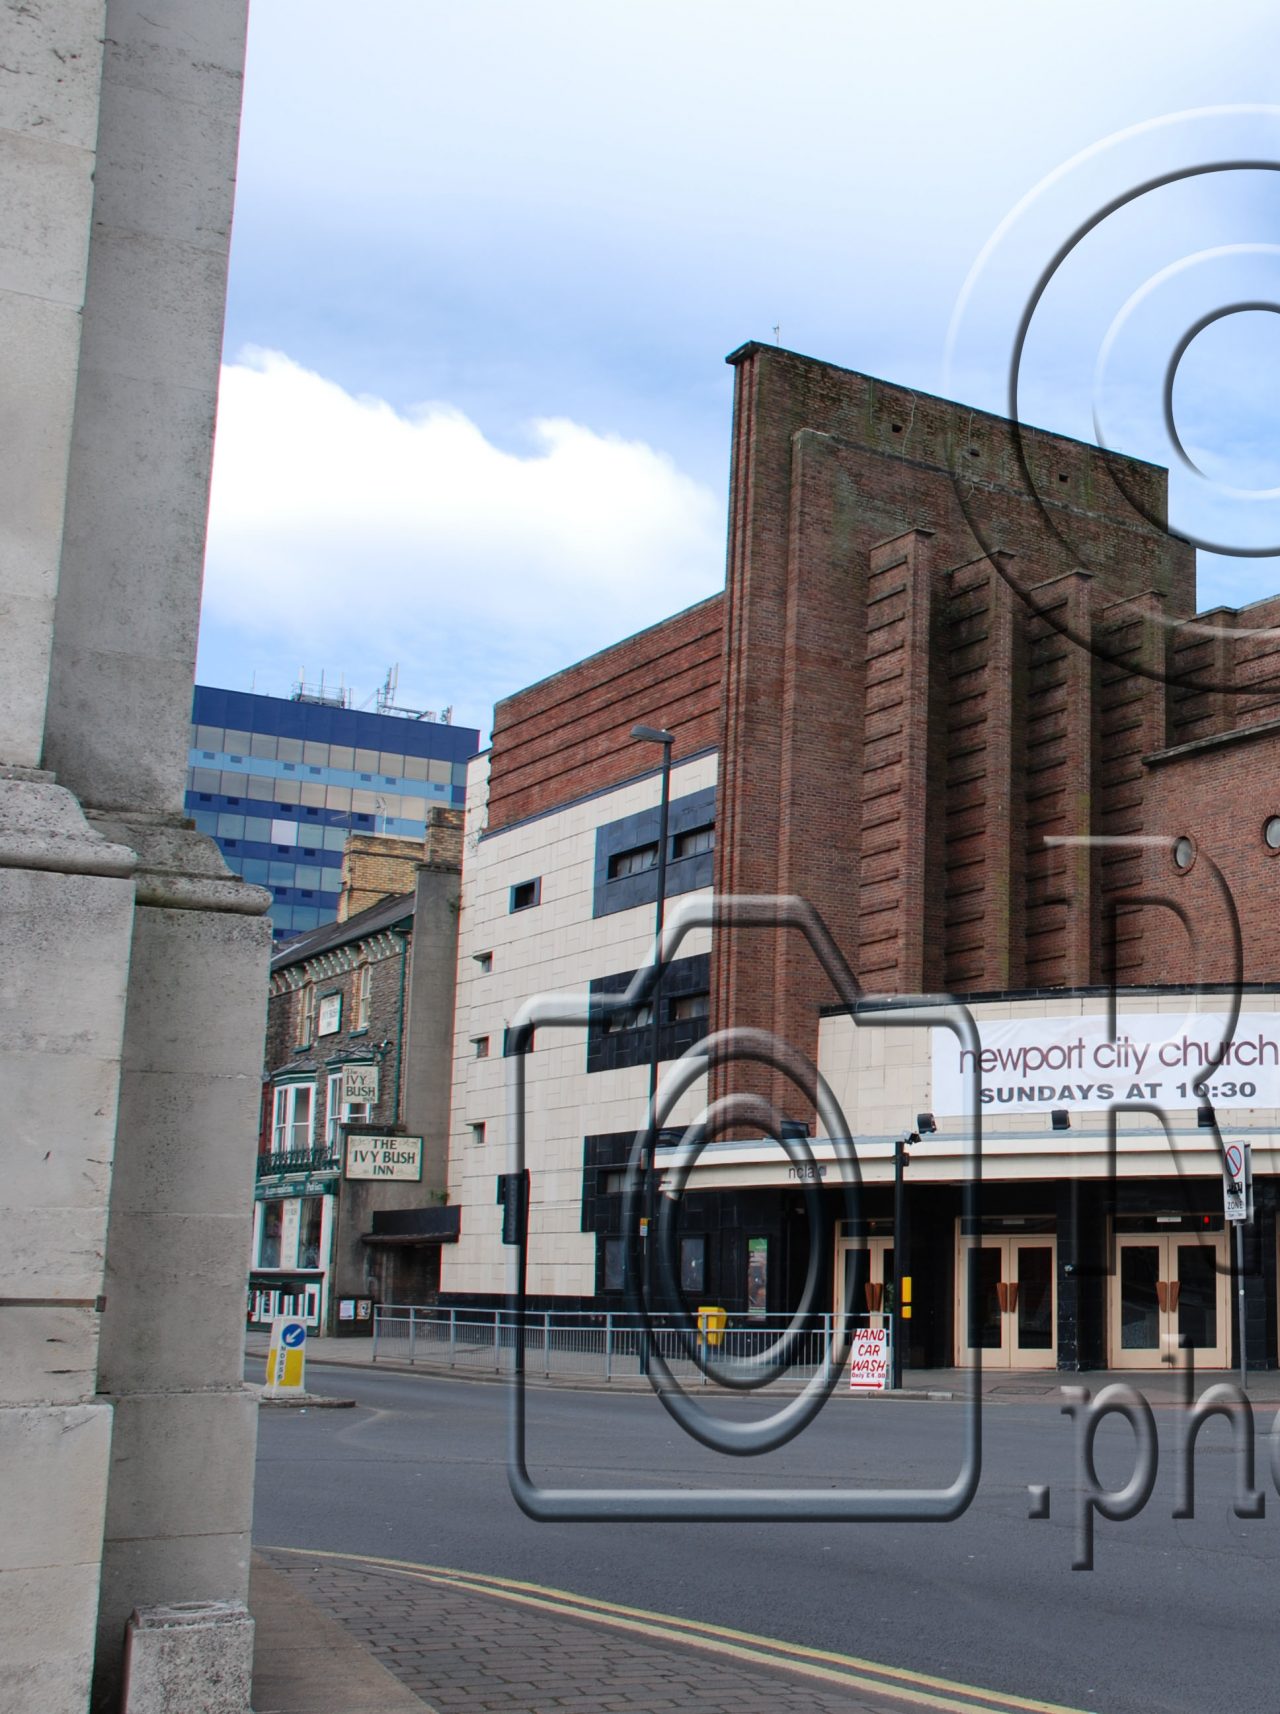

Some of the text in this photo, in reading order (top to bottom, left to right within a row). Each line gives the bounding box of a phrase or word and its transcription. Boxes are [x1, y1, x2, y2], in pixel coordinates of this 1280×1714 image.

[960, 1034, 1279, 1078] newport city church
[346, 1075, 368, 1086] IVY
[346, 1086, 376, 1097] BUSH
[981, 1081, 1257, 1104] SUNDAYS AT 10:30
[371, 1139, 398, 1149] THE
[354, 1150, 416, 1164] IVY BUSH
[373, 1165, 395, 1176] INN
[854, 1329, 885, 1342] HAND
[858, 1344, 881, 1357] CAR
[852, 1360, 886, 1372] WASH
